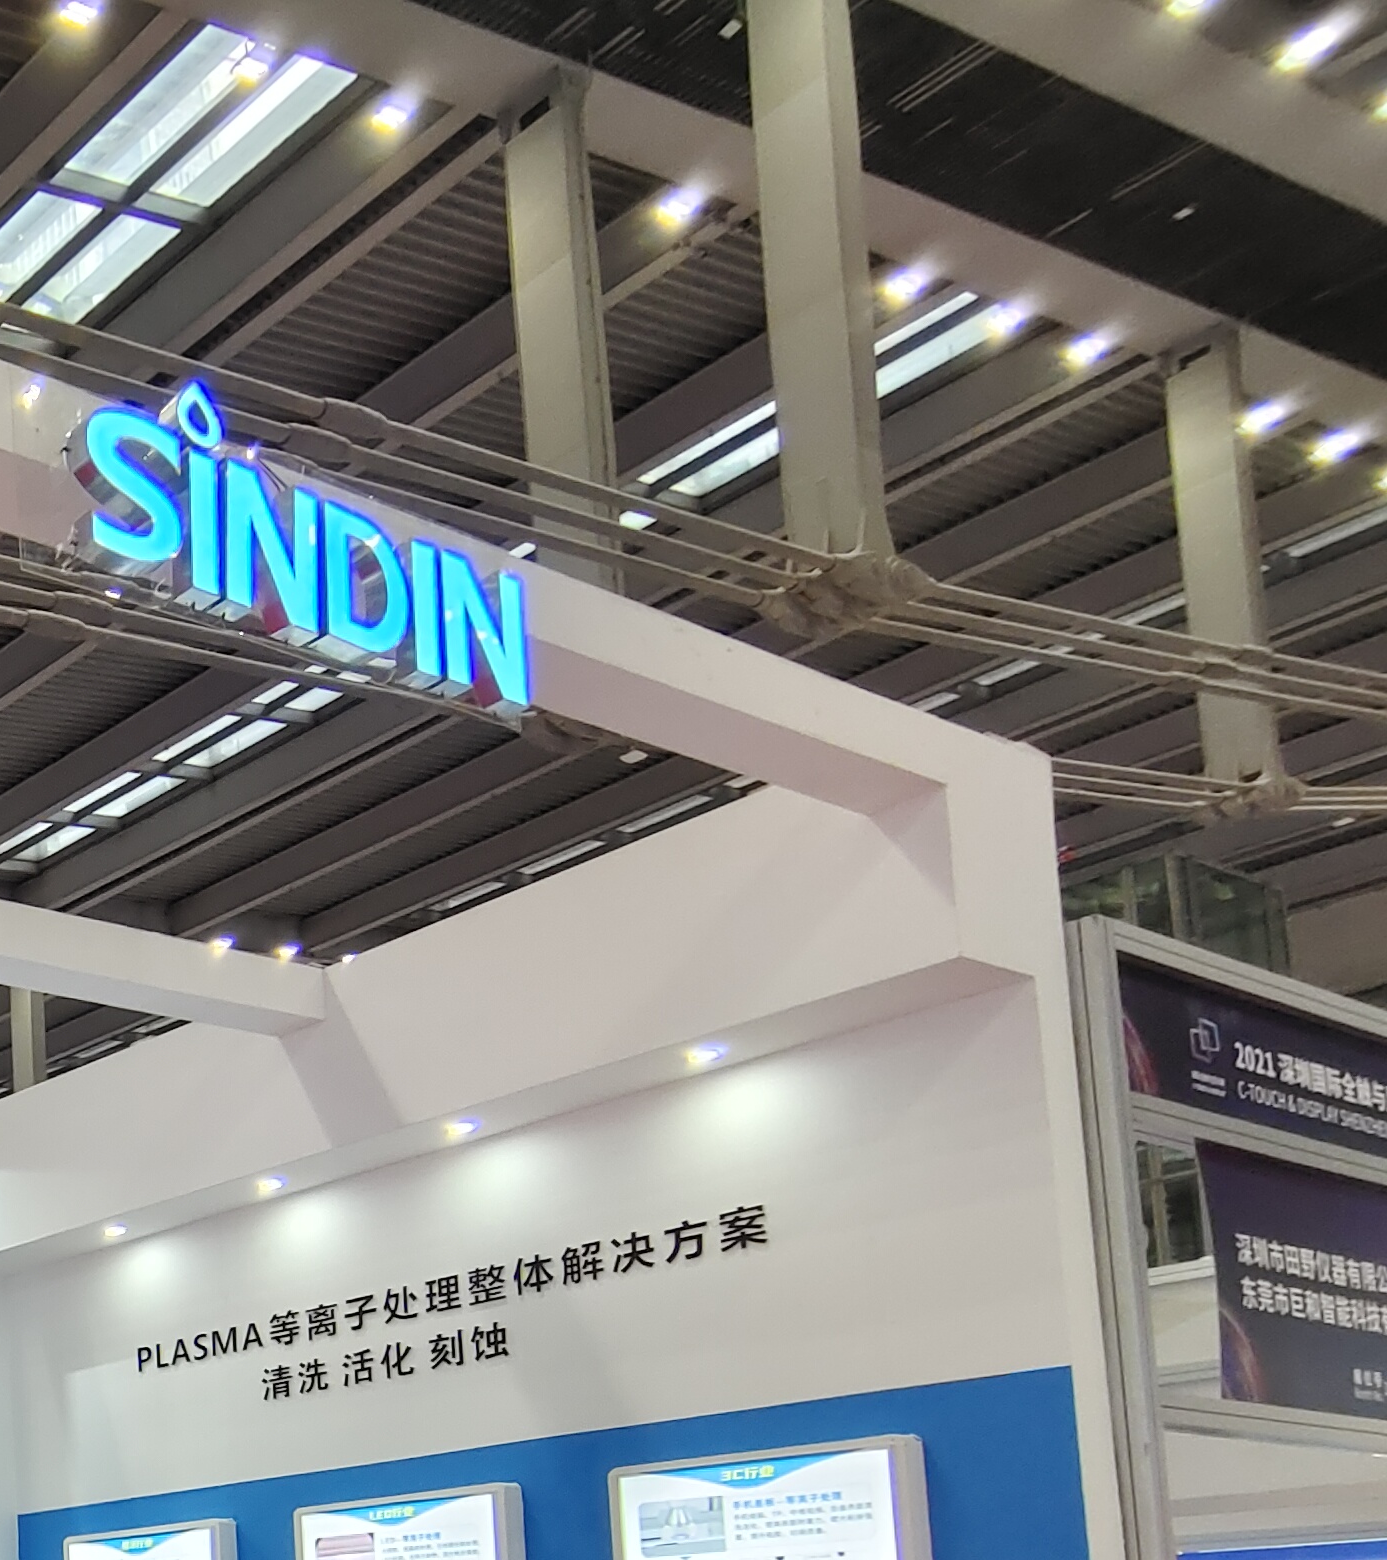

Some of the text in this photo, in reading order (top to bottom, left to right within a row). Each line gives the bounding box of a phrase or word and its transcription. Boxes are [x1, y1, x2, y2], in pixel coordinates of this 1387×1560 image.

[85, 380, 529, 707] SINDIN
[1234, 1041, 1277, 1078] 2021
[1277, 1053, 1387, 1113] 深圳国际全触与
[260, 1321, 511, 1402] 清洗 活化 刻蚀
